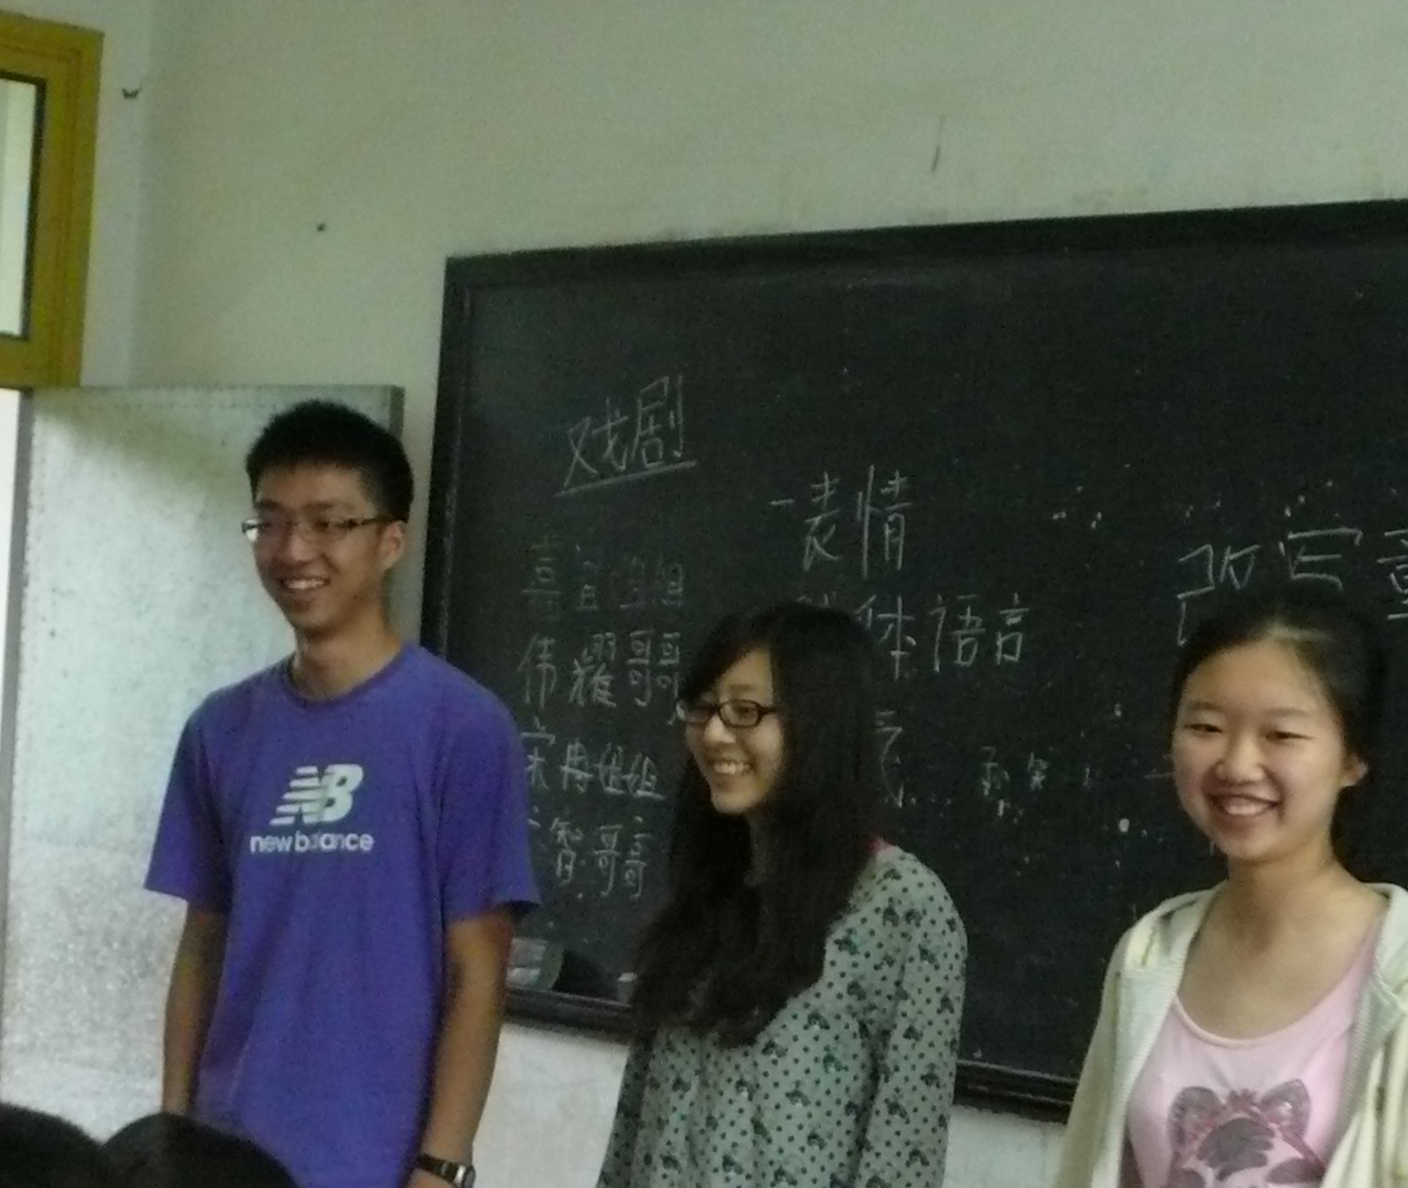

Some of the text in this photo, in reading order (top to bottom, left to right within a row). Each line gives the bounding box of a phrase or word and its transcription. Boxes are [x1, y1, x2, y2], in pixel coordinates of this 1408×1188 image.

[562, 373, 686, 489] 戏剧
[797, 590, 1030, 680] 体语言
